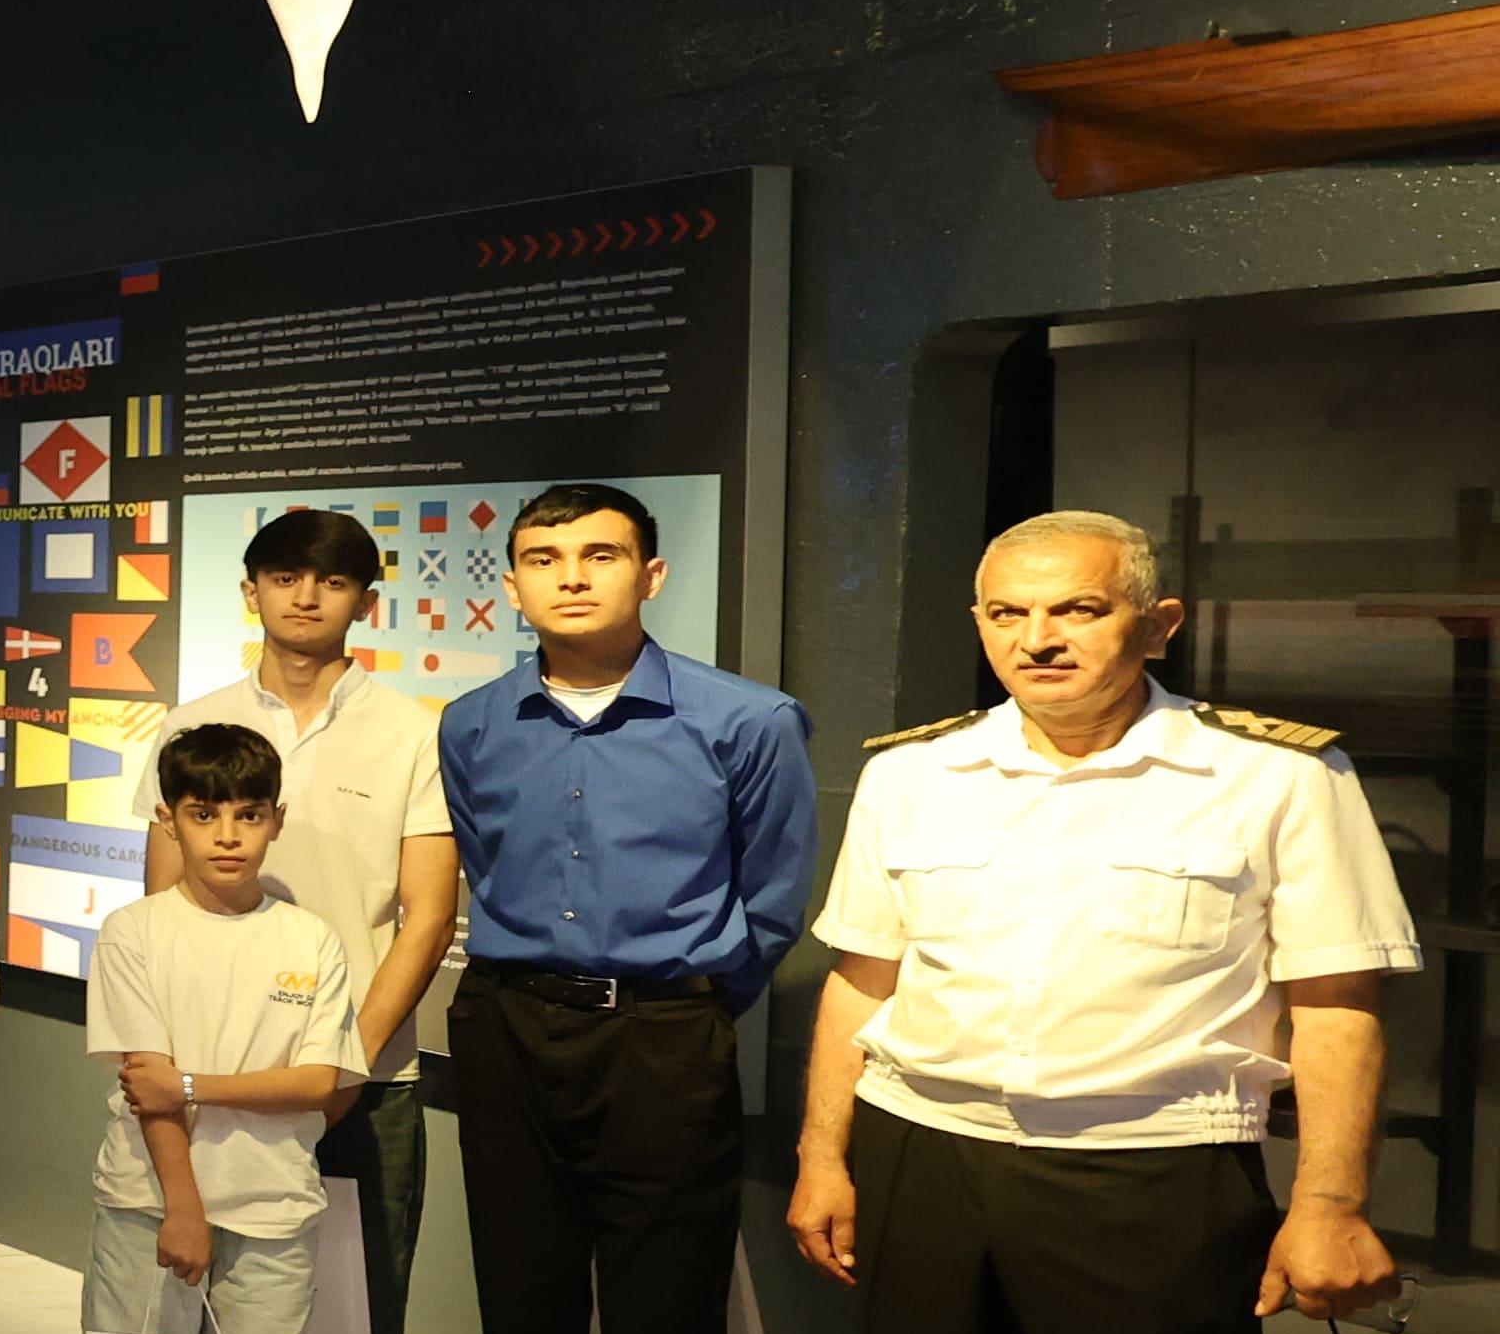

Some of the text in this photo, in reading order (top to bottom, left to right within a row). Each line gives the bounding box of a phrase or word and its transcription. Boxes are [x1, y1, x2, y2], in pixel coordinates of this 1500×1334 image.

[19, 367, 88, 396] FLAGS
[58, 449, 77, 479] F
[69, 504, 112, 520] WITH
[115, 502, 150, 518] YOU
[93, 637, 113, 666] B
[27, 667, 49, 697] 4
[45, 709, 67, 724] MY
[11, 832, 102, 856] DANGEROUS
[84, 887, 95, 914] J
